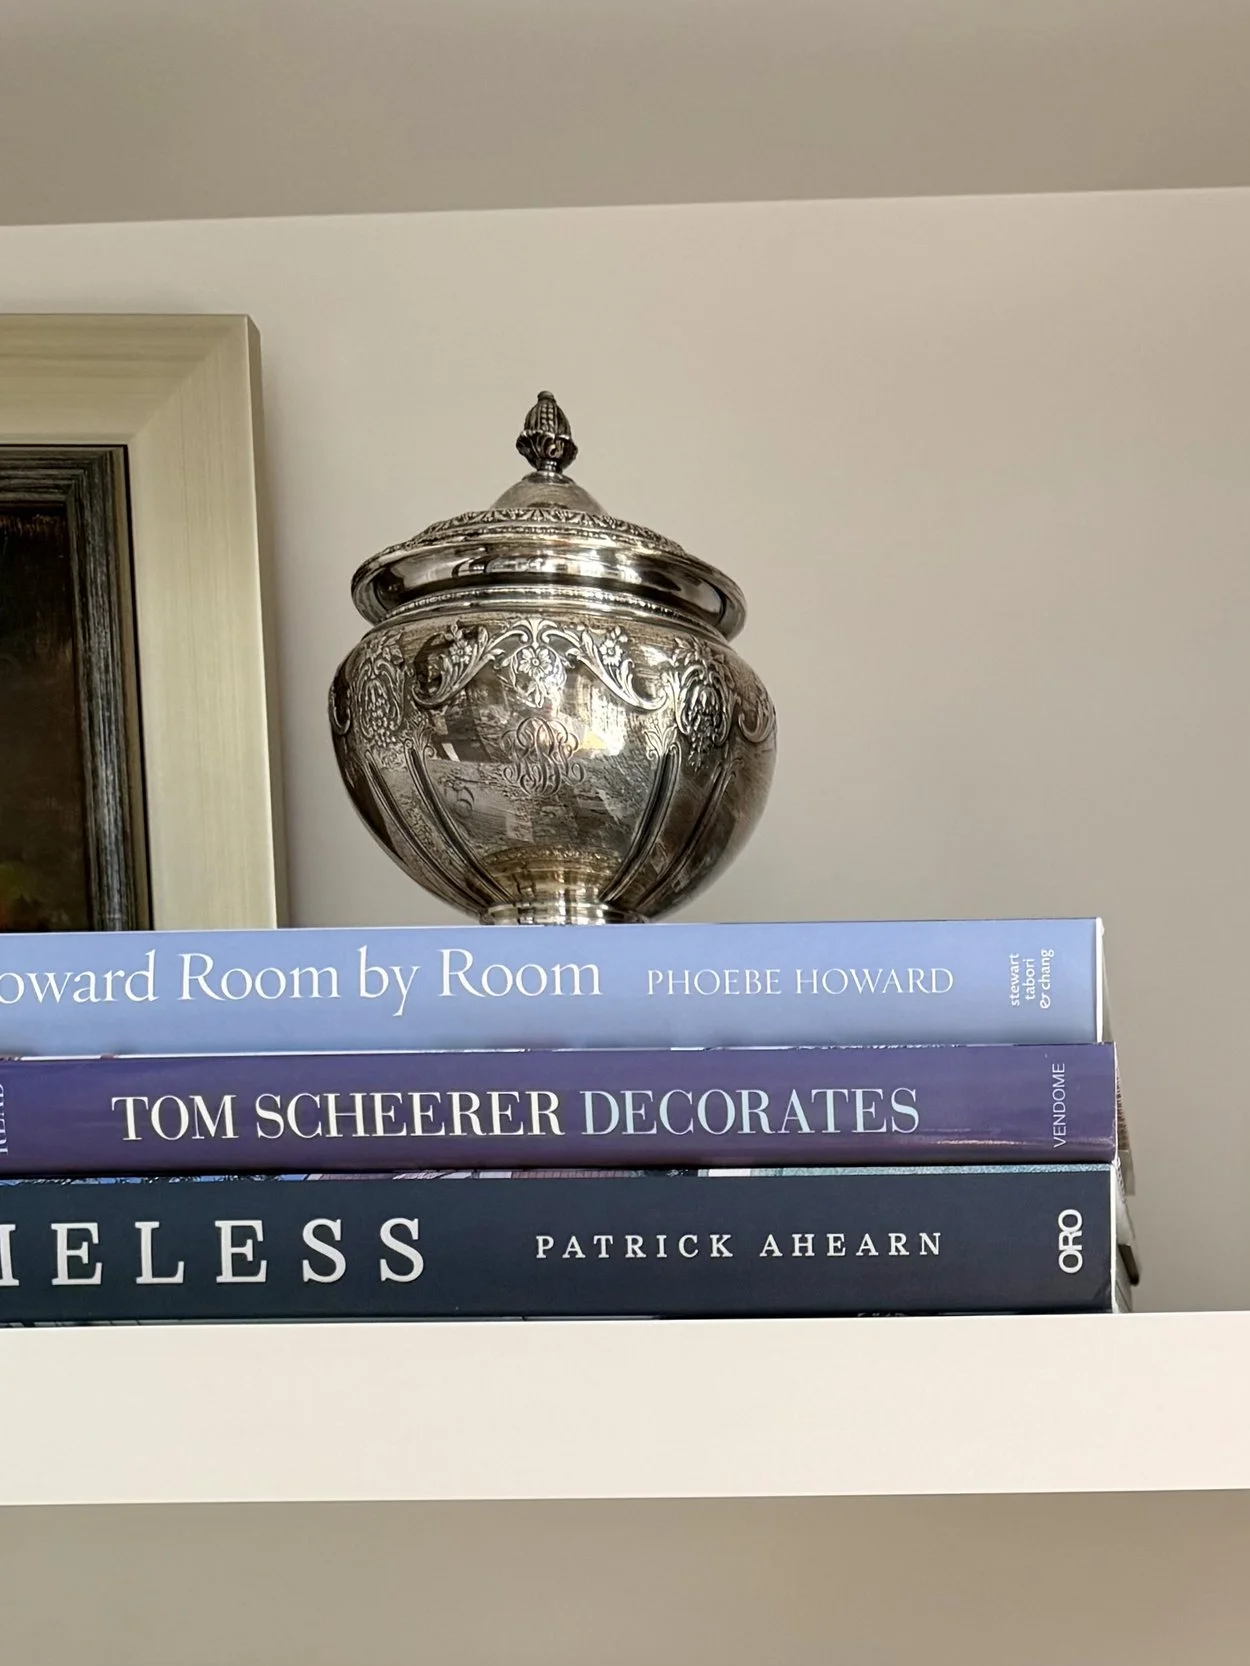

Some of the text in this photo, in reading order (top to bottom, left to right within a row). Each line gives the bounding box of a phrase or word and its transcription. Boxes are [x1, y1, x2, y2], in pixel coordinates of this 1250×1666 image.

[177, 952, 341, 1002] Room
[358, 945, 420, 1017] by
[438, 947, 604, 999] Room
[647, 966, 955, 996] PHOEBE HOWARD
[1009, 952, 1020, 1007] stewart
[1023, 958, 1036, 1001] tabori
[1038, 948, 1055, 991] chang
[111, 1087, 921, 1141] TOM SCHEERER DECORATES
[1051, 1062, 1066, 1148] VENDOME
[536, 1231, 943, 1260] PATRICK AHEARN
[1057, 1208, 1084, 1275] ORO
